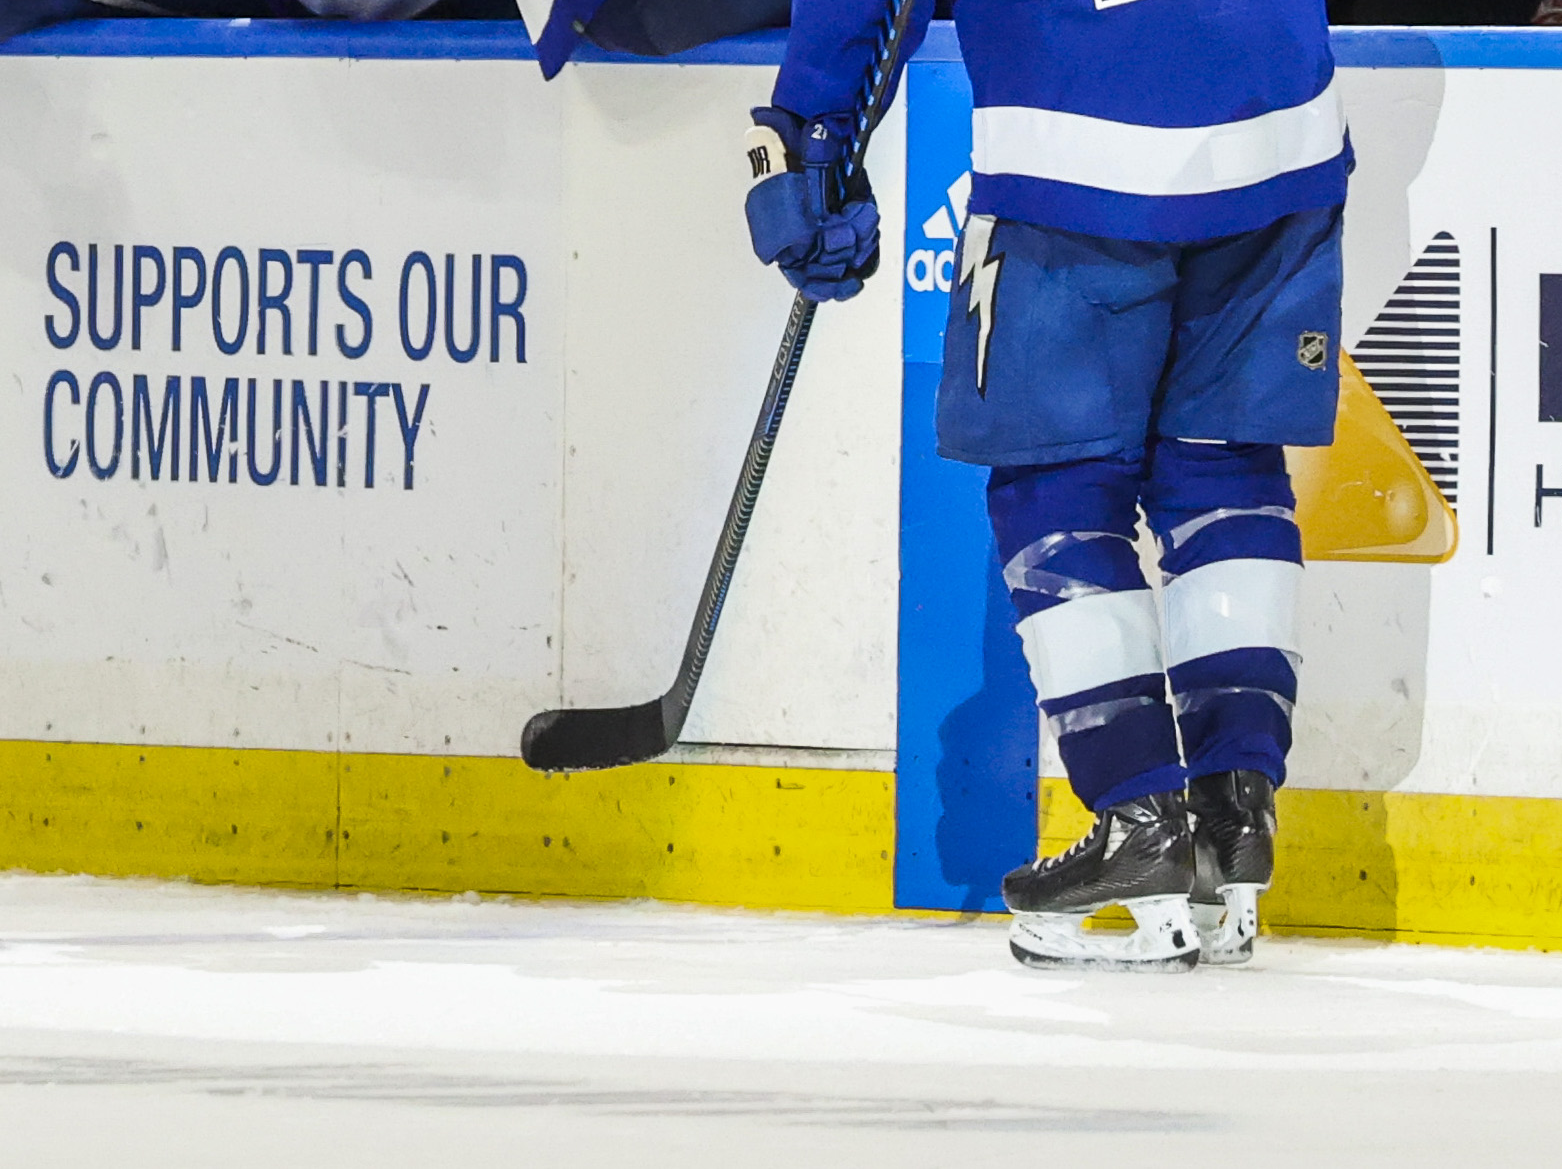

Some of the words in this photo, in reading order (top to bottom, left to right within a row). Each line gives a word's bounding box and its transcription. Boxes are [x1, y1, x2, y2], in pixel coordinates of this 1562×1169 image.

[44, 240, 374, 359] SUPPORTS
[399, 250, 528, 363] OUR
[43, 369, 431, 490] COMMUNITY
